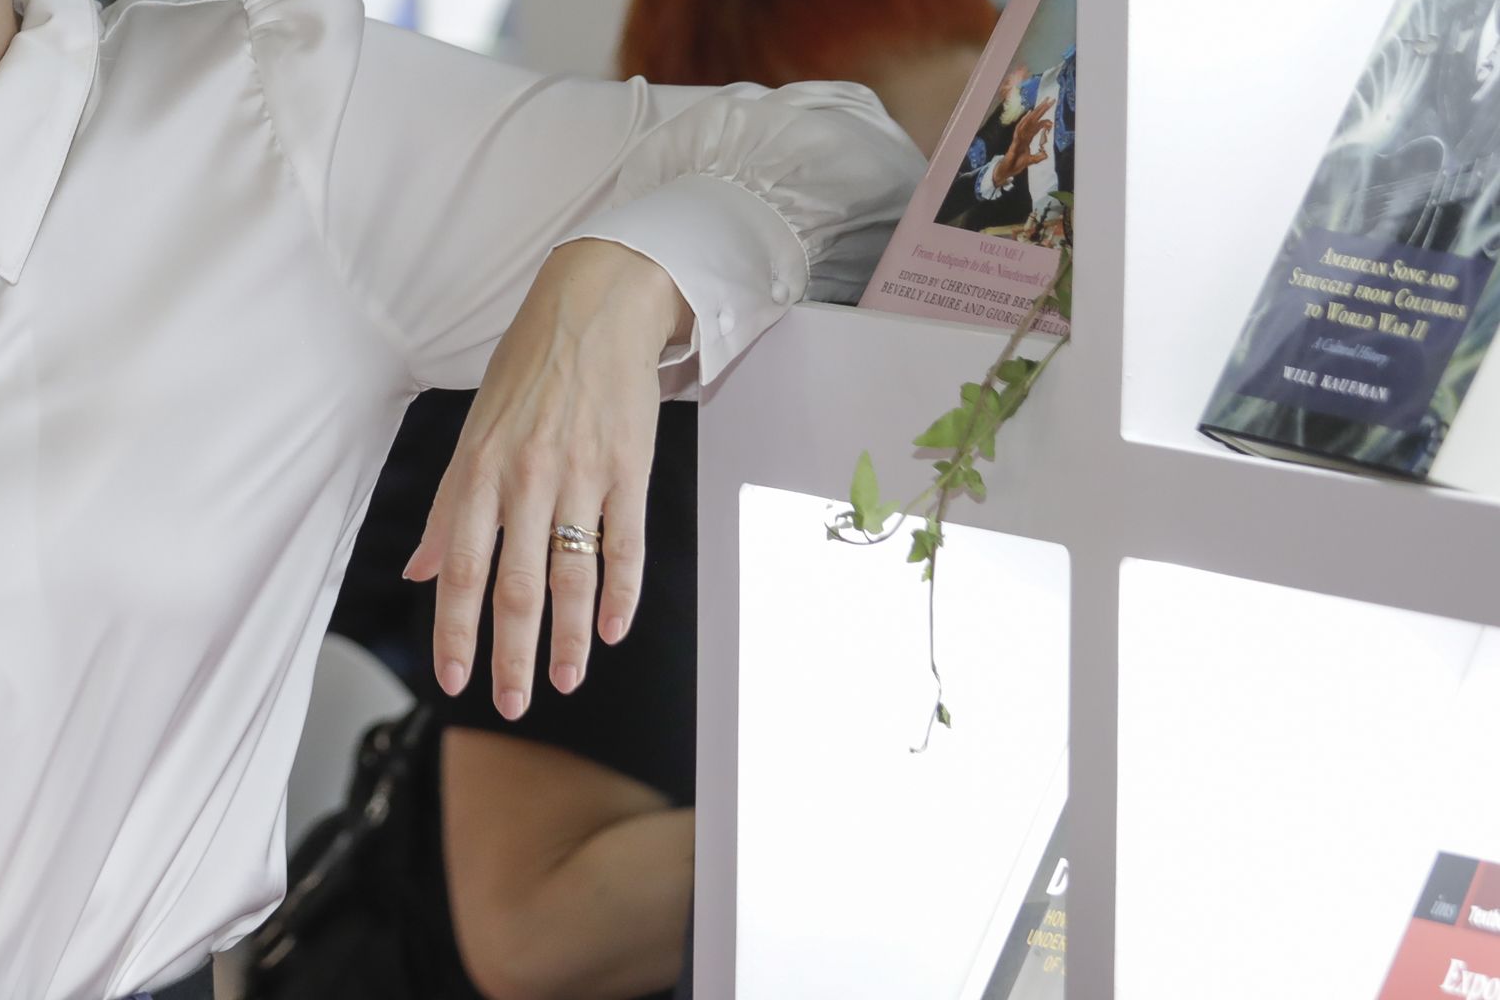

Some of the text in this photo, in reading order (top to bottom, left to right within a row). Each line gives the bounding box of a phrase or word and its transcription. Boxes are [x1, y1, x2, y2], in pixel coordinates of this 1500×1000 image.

[911, 244, 935, 261] From
[979, 260, 994, 275] the
[1319, 247, 1459, 291] AMERICAN SONG AND
[880, 281, 924, 301] BEVERLY
[924, 291, 963, 311] LEMIRE
[961, 302, 985, 317] AND
[986, 308, 1025, 328] GIORGI
[898, 269, 928, 286] EDITED
[928, 276, 941, 288] BY
[940, 278, 1011, 305] CHRISTOPHER
[1288, 266, 1468, 320] STRUGGLE FROM COLUMBUS
[1304, 301, 1430, 342] TO WORLD WAR II
[1283, 366, 1390, 402] WILL KAUFMAN
[1026, 928, 1067, 953] UNDER
[1439, 958, 1500, 1000] Expo
